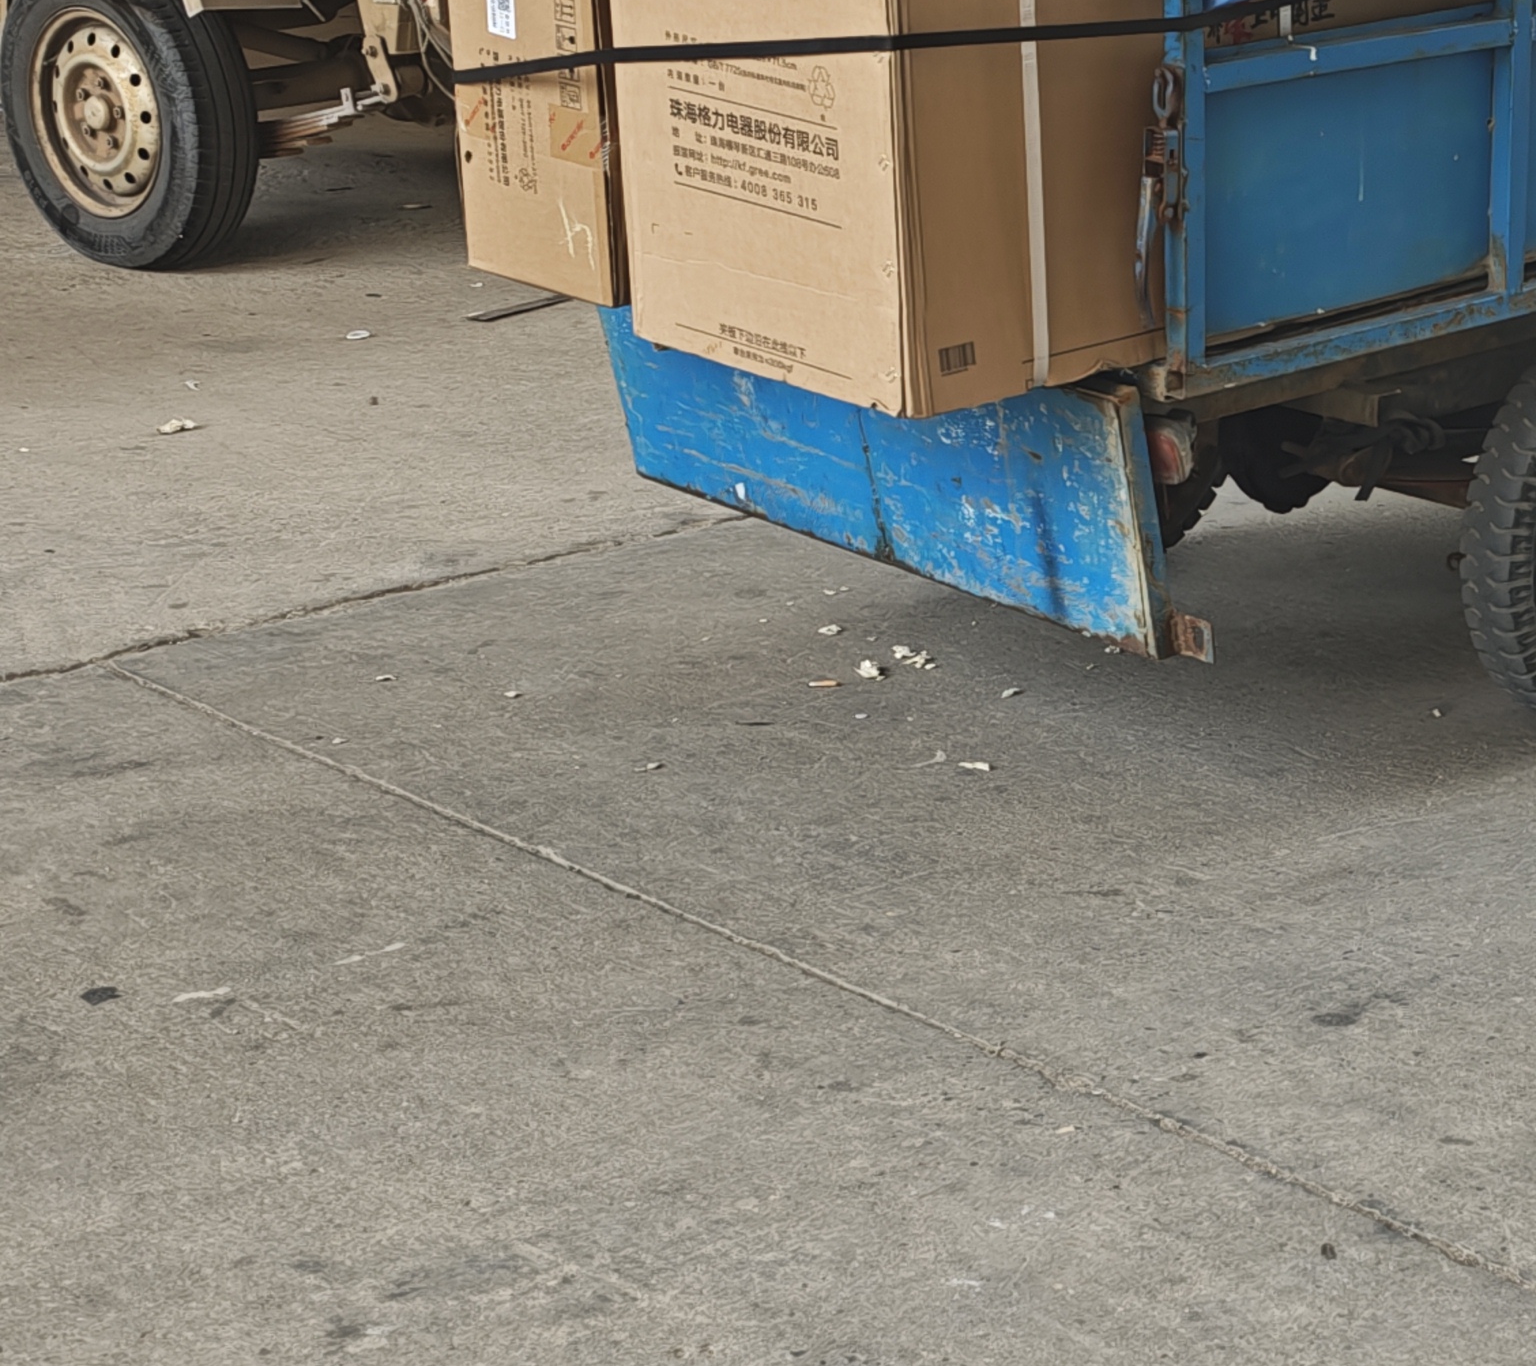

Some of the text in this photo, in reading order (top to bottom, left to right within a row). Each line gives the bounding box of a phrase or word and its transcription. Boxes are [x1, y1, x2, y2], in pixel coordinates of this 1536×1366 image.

[669, 98, 839, 161] 珠海格力电器股份有限公司
